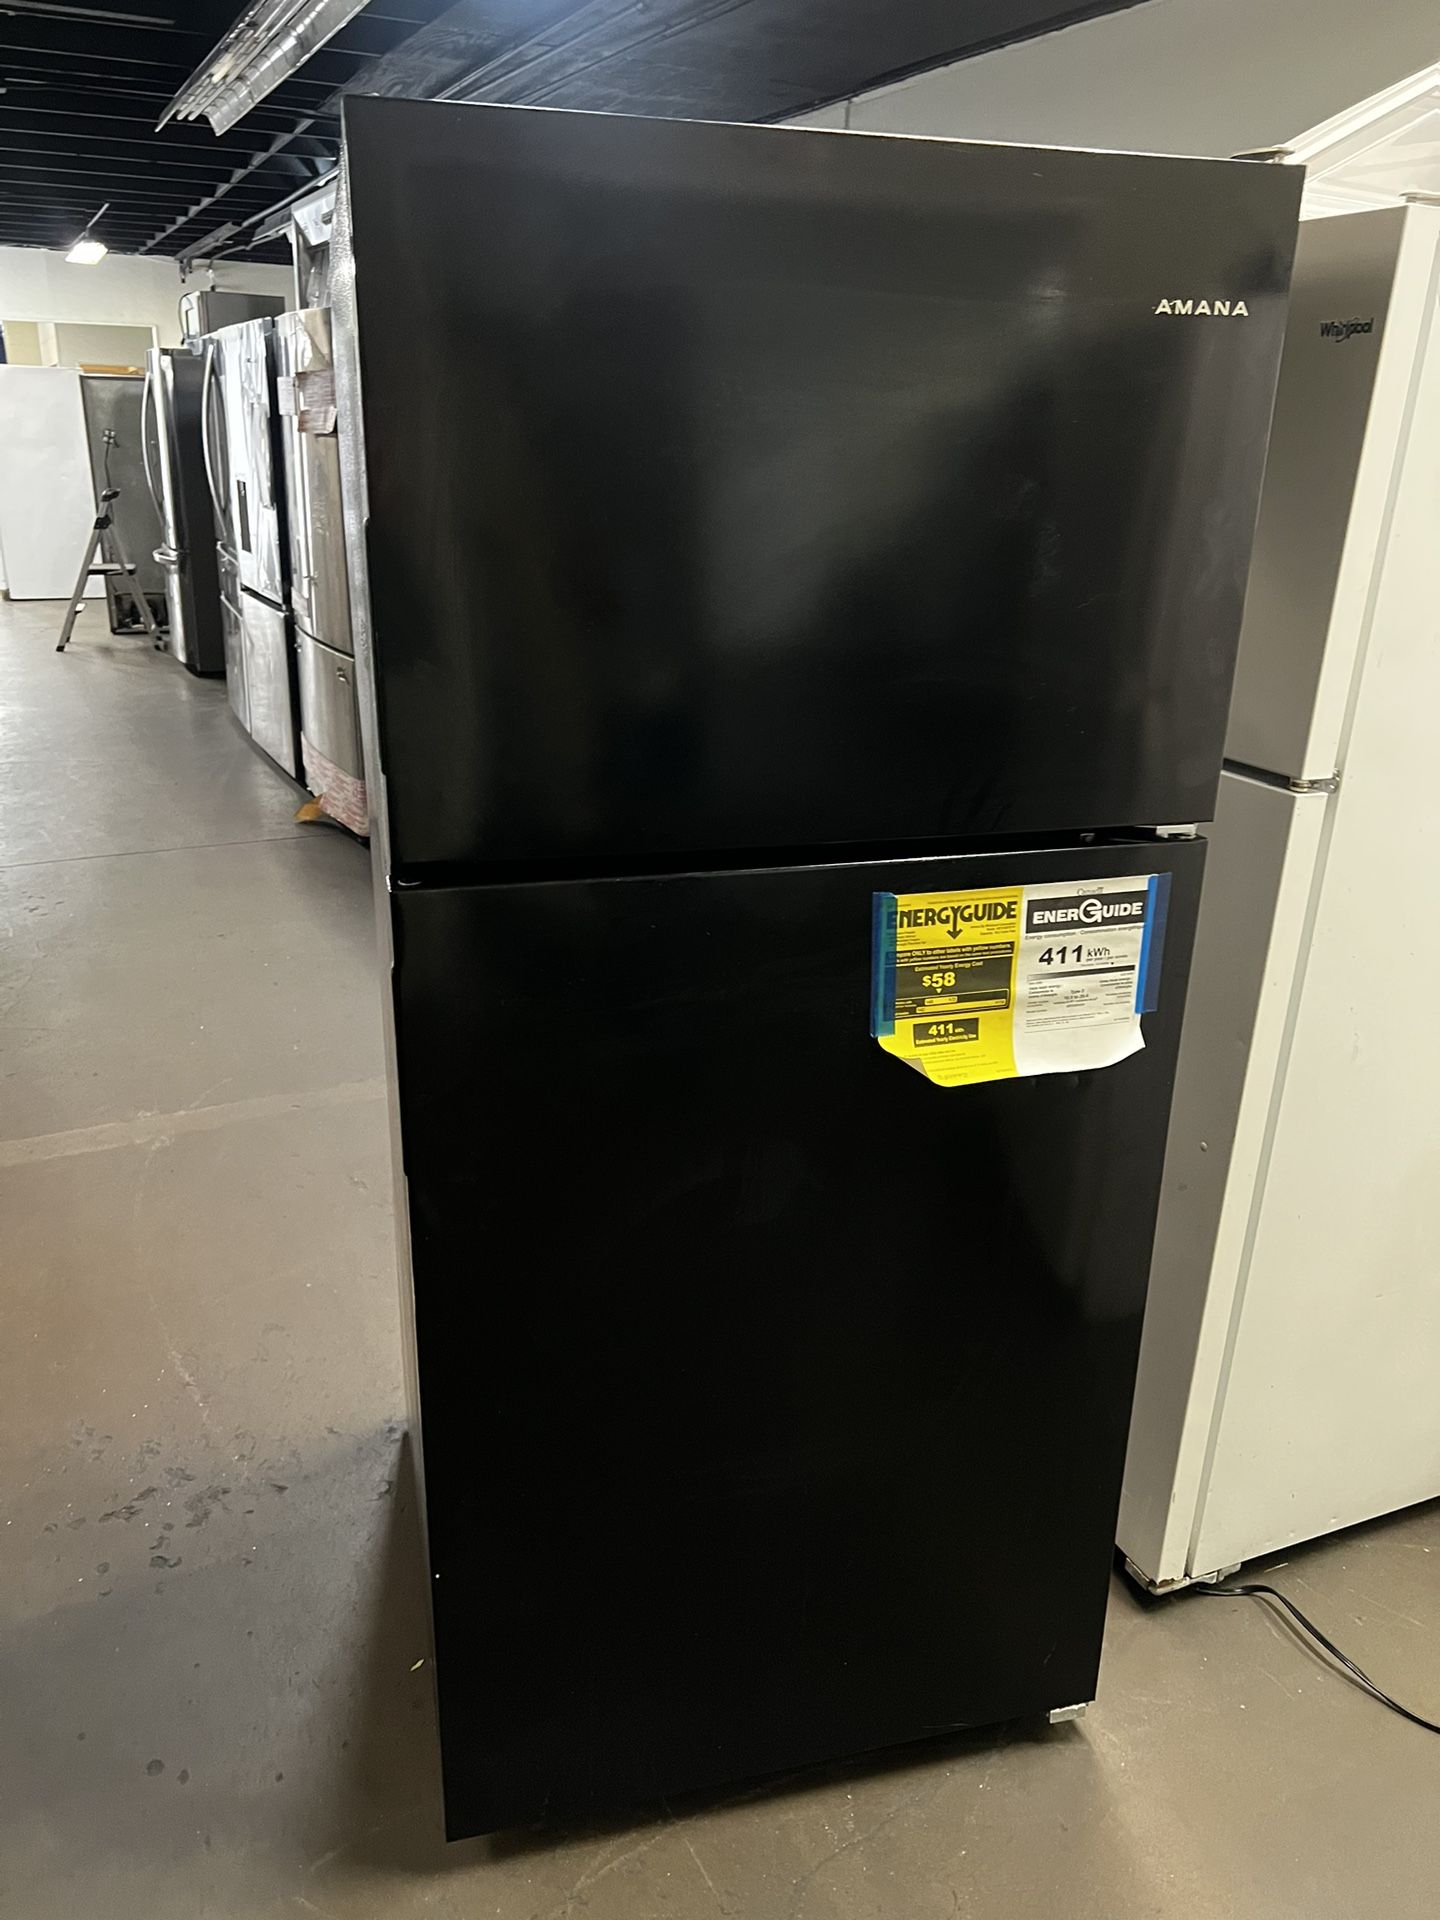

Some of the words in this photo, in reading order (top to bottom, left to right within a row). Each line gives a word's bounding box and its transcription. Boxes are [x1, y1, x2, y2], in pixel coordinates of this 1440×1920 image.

[1155, 299, 1248, 316] AMANA
[1320, 317, 1374, 343] Whirlpool
[1032, 898, 1144, 925] ENERGUIDE
[1038, 945, 1083, 965] 411
[1087, 947, 1110, 958] kWh
[922, 971, 957, 988] $58
[928, 1023, 954, 1036] 411
